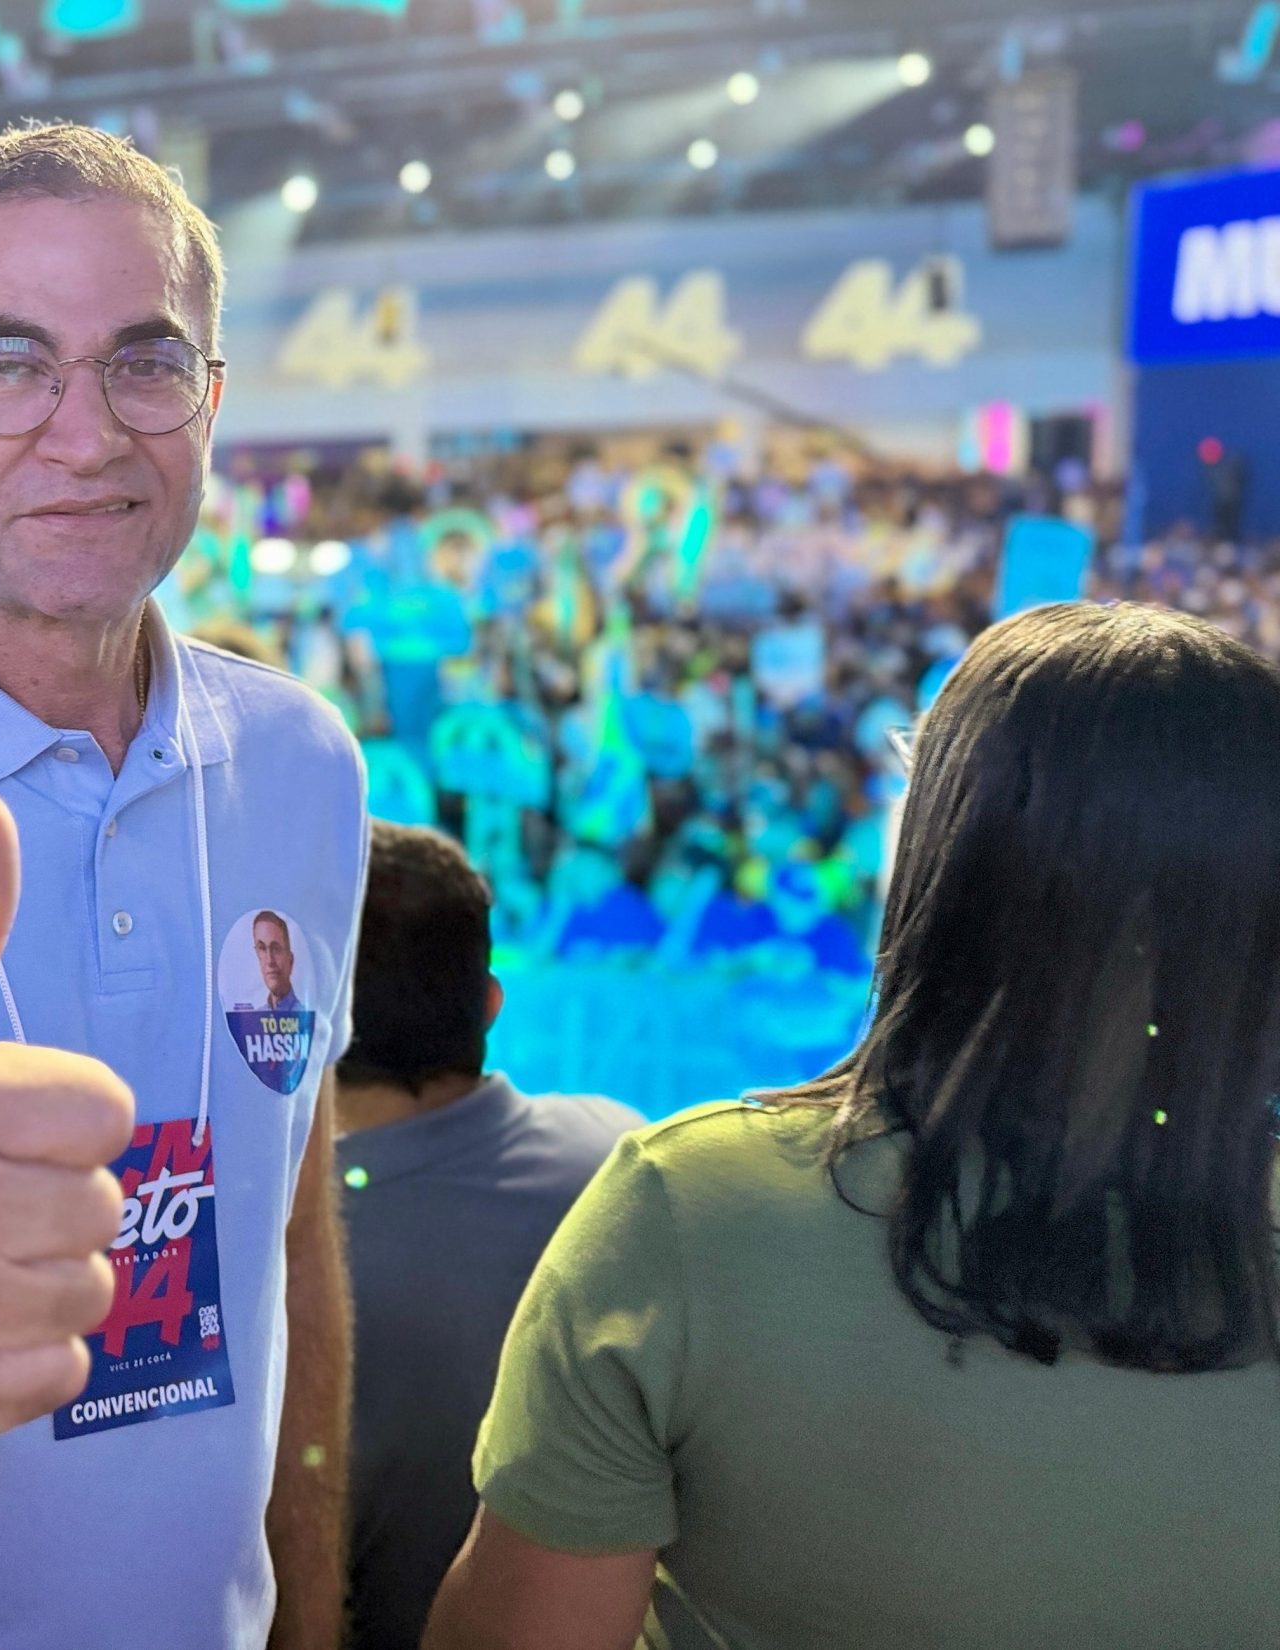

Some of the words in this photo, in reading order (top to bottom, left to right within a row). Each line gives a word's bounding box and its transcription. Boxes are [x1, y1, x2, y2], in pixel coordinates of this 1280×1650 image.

[109, 1167, 215, 1250] eto
[115, 1247, 178, 1266] ERNADOR
[71, 1377, 218, 1424] CONVENCIONAL
